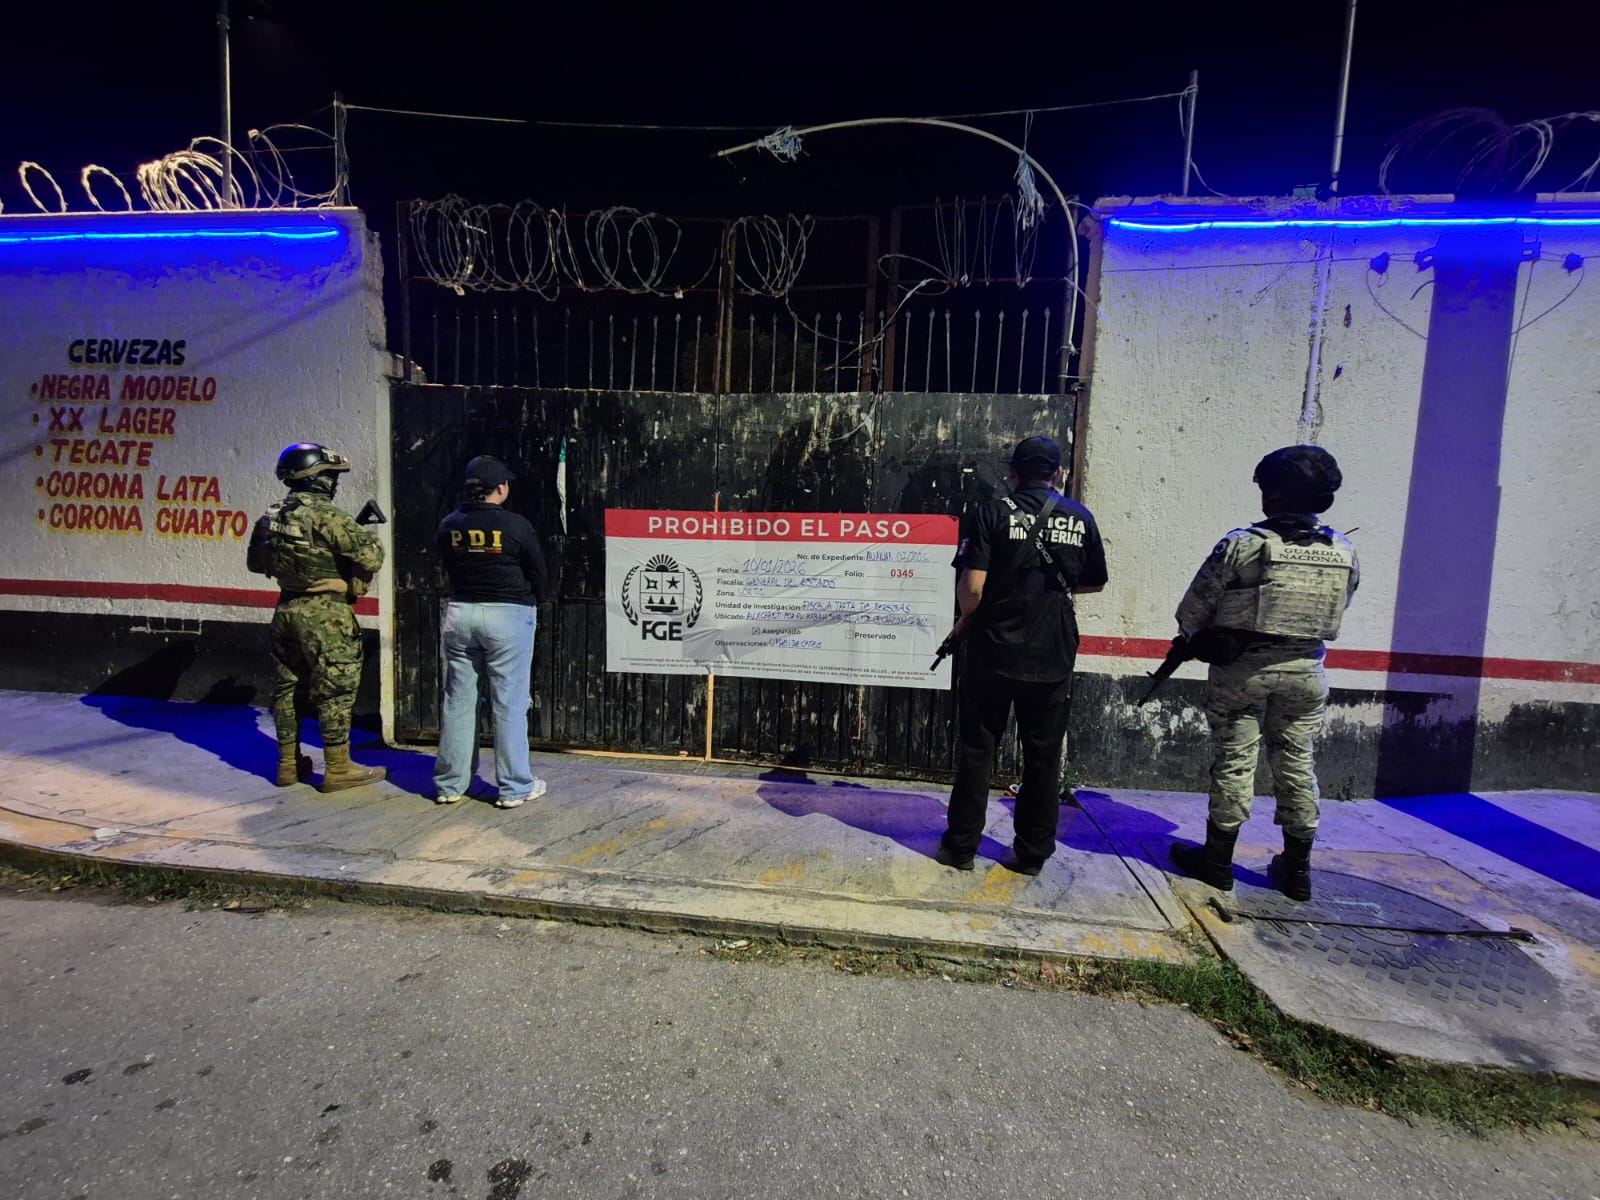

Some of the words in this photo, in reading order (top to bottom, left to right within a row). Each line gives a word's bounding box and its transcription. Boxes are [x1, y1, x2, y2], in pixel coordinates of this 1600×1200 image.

[68, 338, 186, 366] CERVEZAS
[40, 374, 111, 400] NEGRA
[120, 374, 217, 402] MODELO
[47, 406, 84, 433] XX
[99, 406, 176, 435] LAGER
[51, 439, 153, 466] TECATE
[47, 470, 144, 499] CORONA
[156, 474, 221, 503] LATA
[49, 503, 143, 531] CORONA
[156, 507, 248, 537] CUARTO
[648, 516, 791, 537] PROHIBIDO
[800, 519, 830, 537] EL
[839, 519, 911, 539] PASO
[1008, 512, 1086, 535] PICÍA
[450, 529, 503, 547] PDI
[796, 553, 809, 561] No.
[810, 553, 820, 561] de
[821, 553, 865, 562] Expediente:
[1279, 553, 1347, 563] NACIONAL
[1284, 547, 1342, 558] GUARDIA
[844, 569, 865, 578] Folio:
[890, 569, 915, 579] 0345
[715, 601, 741, 609] Unidad
[743, 601, 752, 609] de
[714, 612, 745, 620] Ubicado:
[641, 620, 683, 641] FGE
[761, 628, 802, 636] Asegurado
[854, 632, 897, 641] Preservado
[714, 639, 768, 648] Observaciones:
